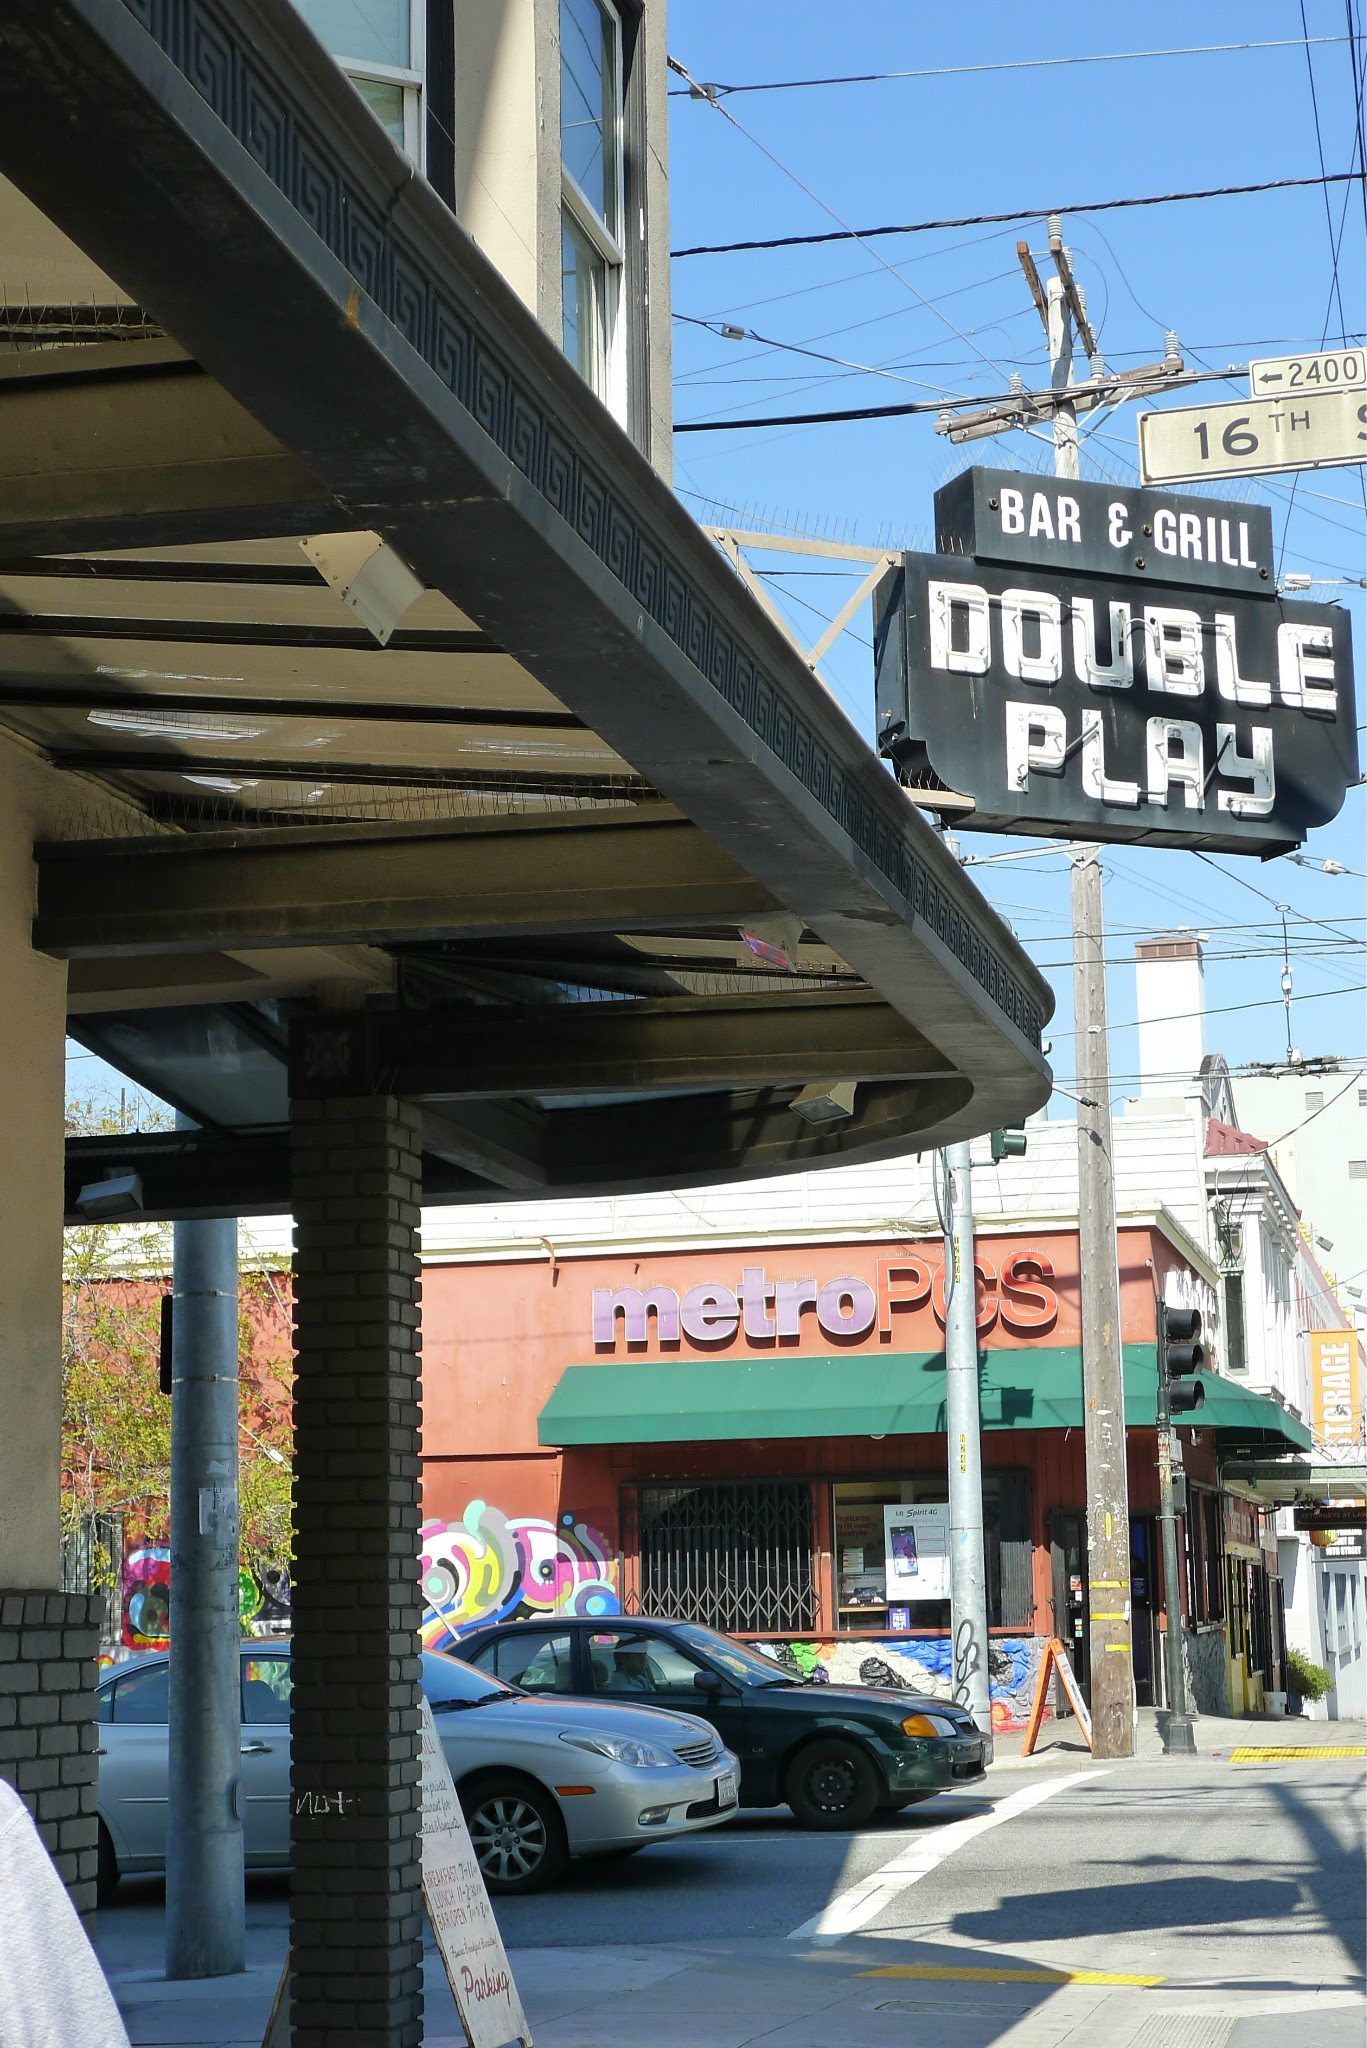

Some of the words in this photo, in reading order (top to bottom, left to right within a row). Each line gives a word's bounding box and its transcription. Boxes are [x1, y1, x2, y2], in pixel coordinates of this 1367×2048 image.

[1288, 355, 1358, 388] 2400
[999, 487, 1082, 543] BAR
[1107, 502, 1133, 549] &
[1154, 509, 1258, 569] GRILL
[928, 580, 1339, 711] DOUBLE
[1005, 700, 1276, 815] PLAY
[591, 1250, 1059, 1343] metroPCS
[424, 1865, 461, 1889] BREAKFAST
[432, 1888, 457, 1910] LUNCH
[460, 1963, 511, 2008] Parking
